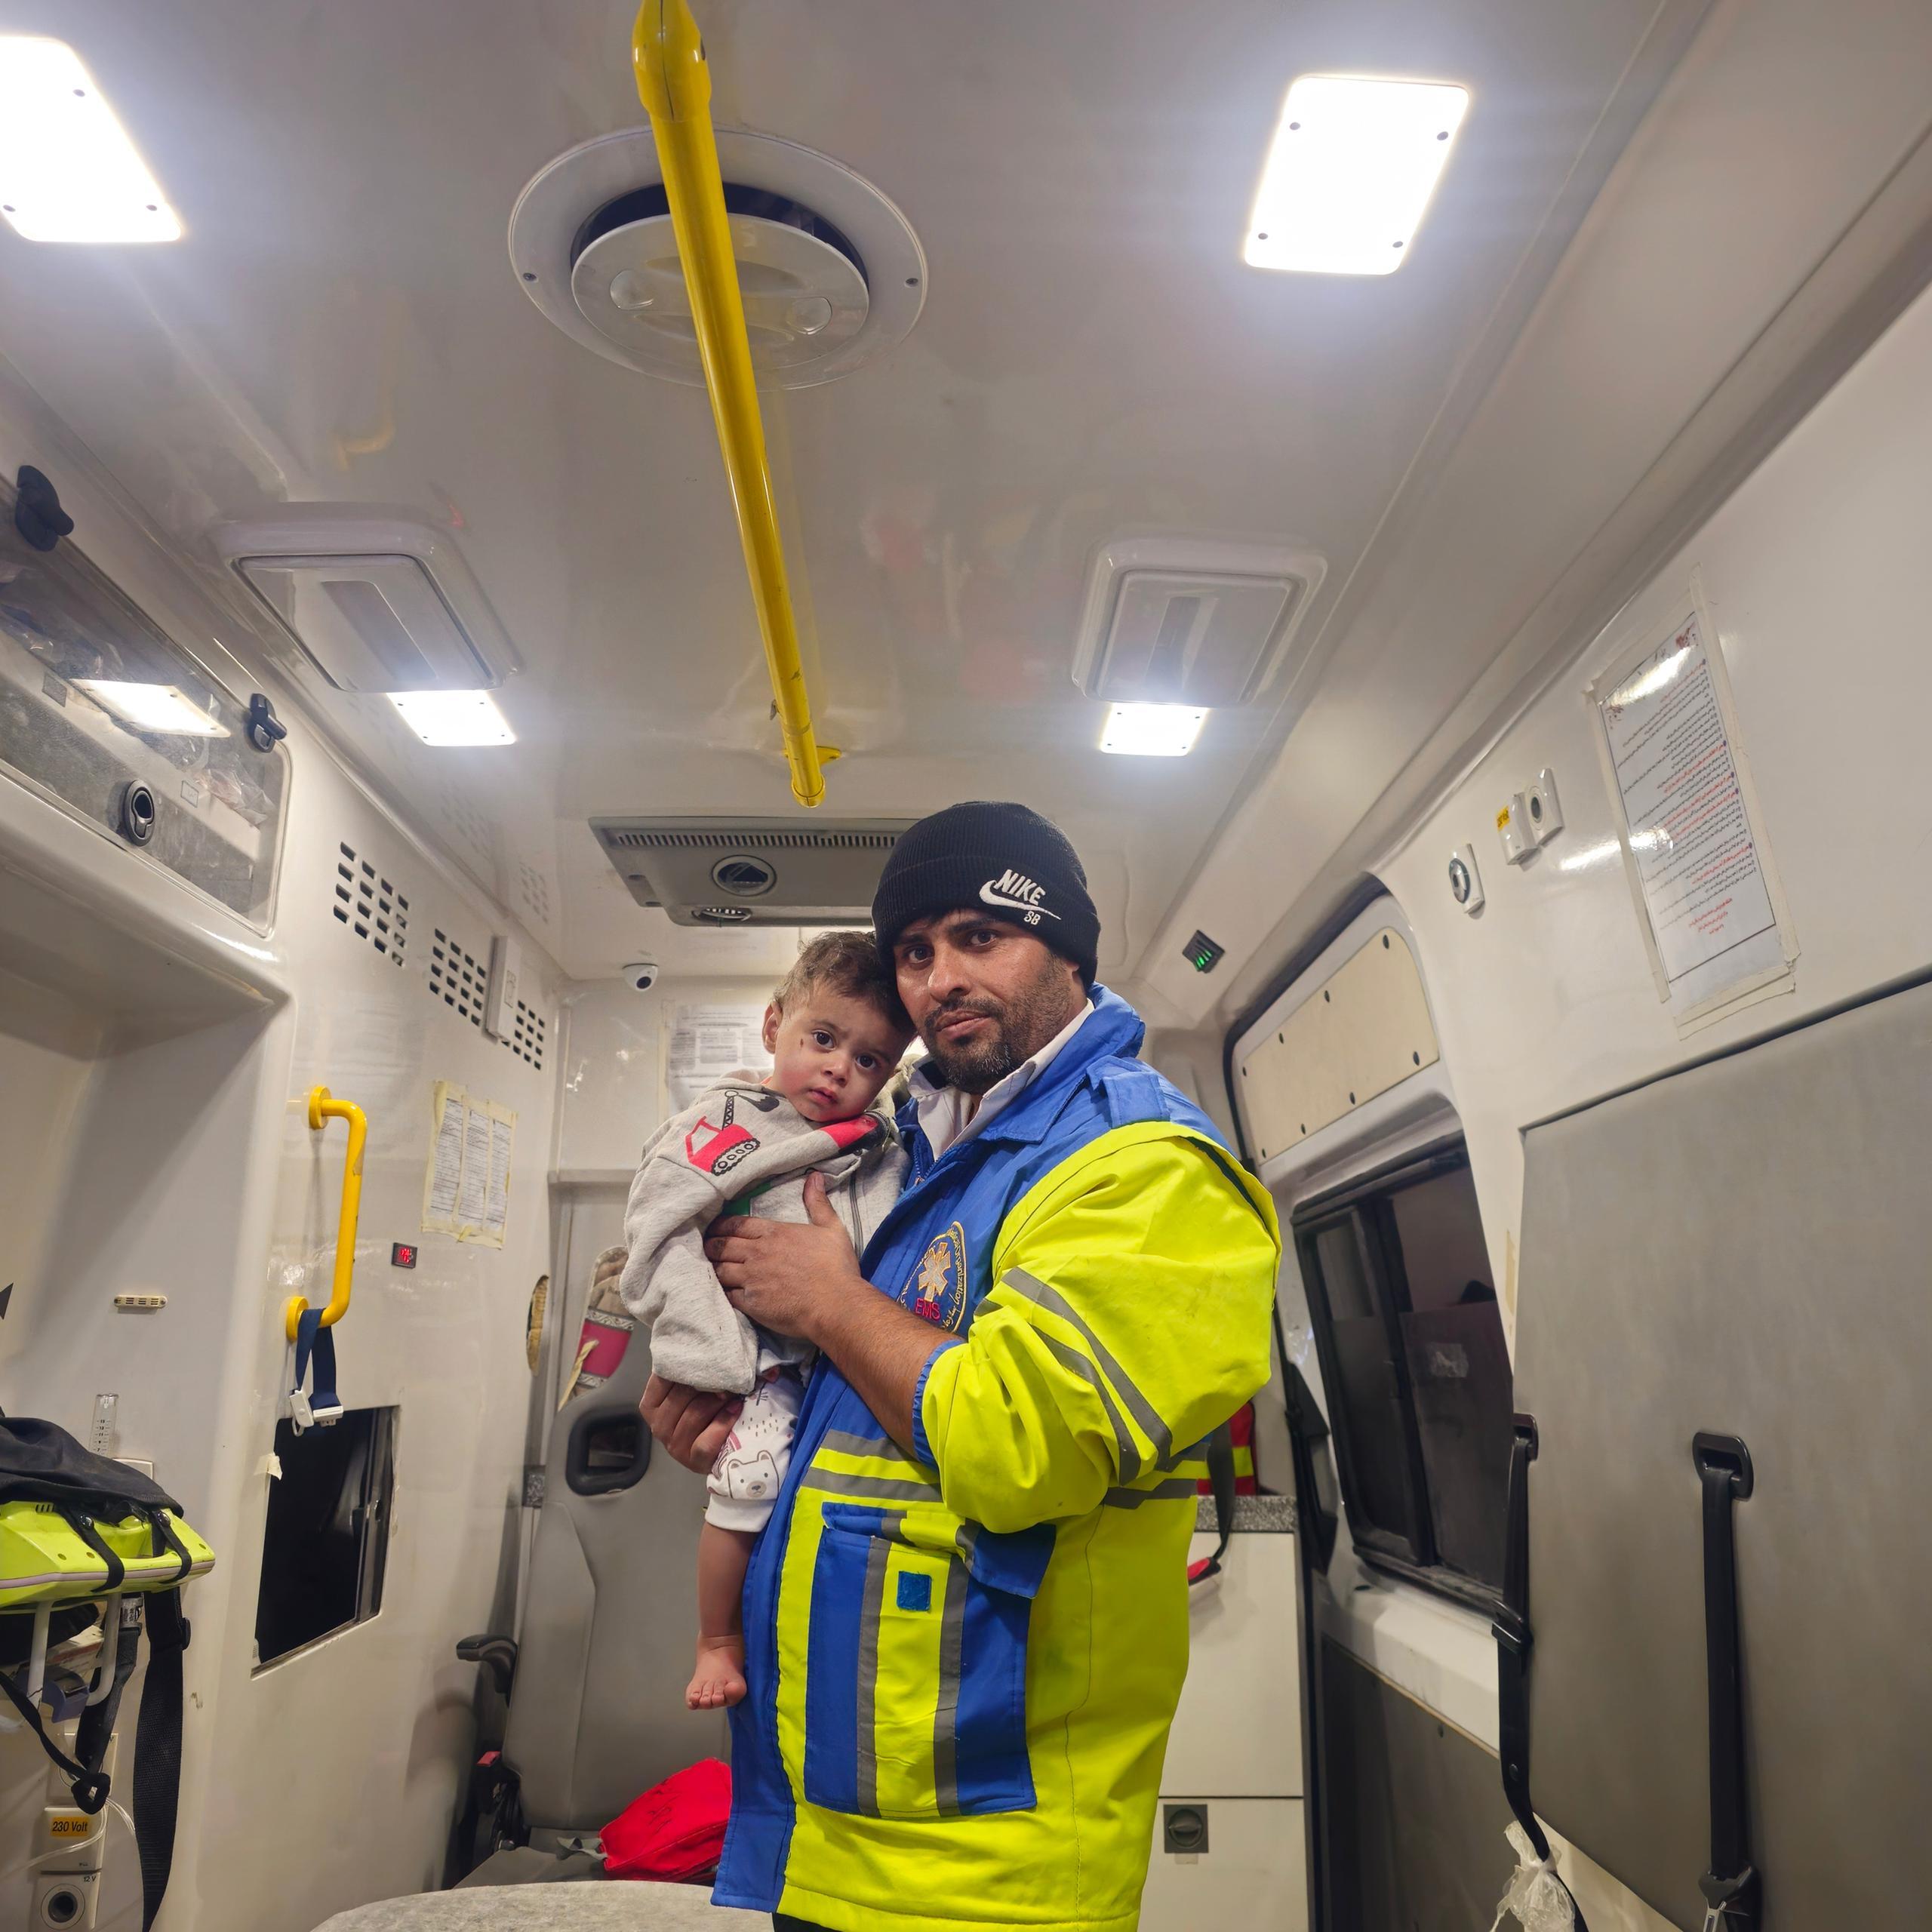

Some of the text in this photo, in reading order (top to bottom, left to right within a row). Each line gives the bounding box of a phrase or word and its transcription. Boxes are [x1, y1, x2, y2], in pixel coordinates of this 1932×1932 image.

[993, 869, 1046, 906] NIKE
[1023, 910, 1041, 925] SB
[949, 1244, 964, 1306] Organization
[915, 1297, 940, 1321] EMS
[52, 1821, 88, 1832] 230 Volt
